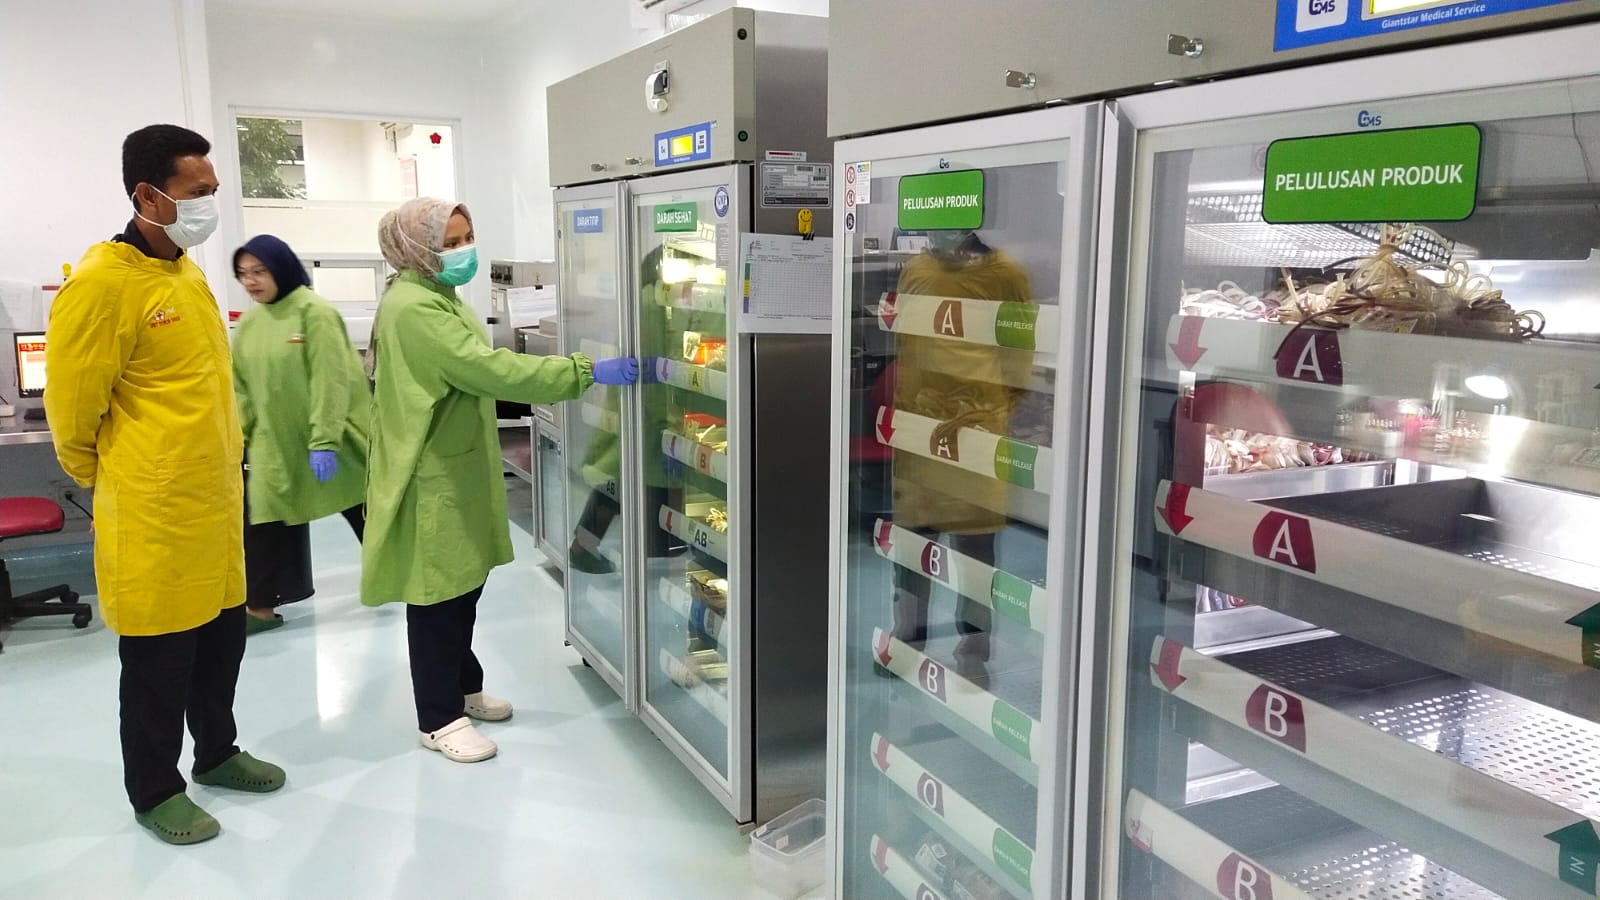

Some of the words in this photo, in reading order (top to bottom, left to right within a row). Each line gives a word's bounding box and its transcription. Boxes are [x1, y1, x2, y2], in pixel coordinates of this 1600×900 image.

[1382, 16, 1419, 29] Giantstar
[1420, 9, 1453, 23] Medical
[1454, 3, 1486, 17] Service
[1275, 168, 1375, 191] PELULUSAN
[1382, 164, 1465, 186] PRODUK
[903, 197, 944, 210] PELULUSAN
[946, 194, 979, 208] PRODUK
[657, 213, 675, 225] DARAH
[675, 210, 693, 224] SEHAT
[941, 303, 956, 335] A
[996, 319, 1013, 329] DARAH
[1013, 320, 1034, 331] RELEASE
[1292, 334, 1324, 382] A
[692, 371, 699, 387] A
[700, 453, 706, 468] B
[996, 454, 1012, 465] DARAH
[1012, 458, 1033, 471] RELEASE
[694, 529, 708, 547] AB
[1269, 519, 1298, 566] A
[929, 544, 941, 576] B
[992, 588, 1008, 600] DARAH
[1008, 594, 1028, 609] RELEASE
[926, 662, 938, 693] B
[1264, 690, 1288, 738] B
[1008, 726, 1028, 743] RELEASE
[923, 778, 937, 809] O
[1569, 856, 1585, 876] IN
[1234, 860, 1257, 900] B
